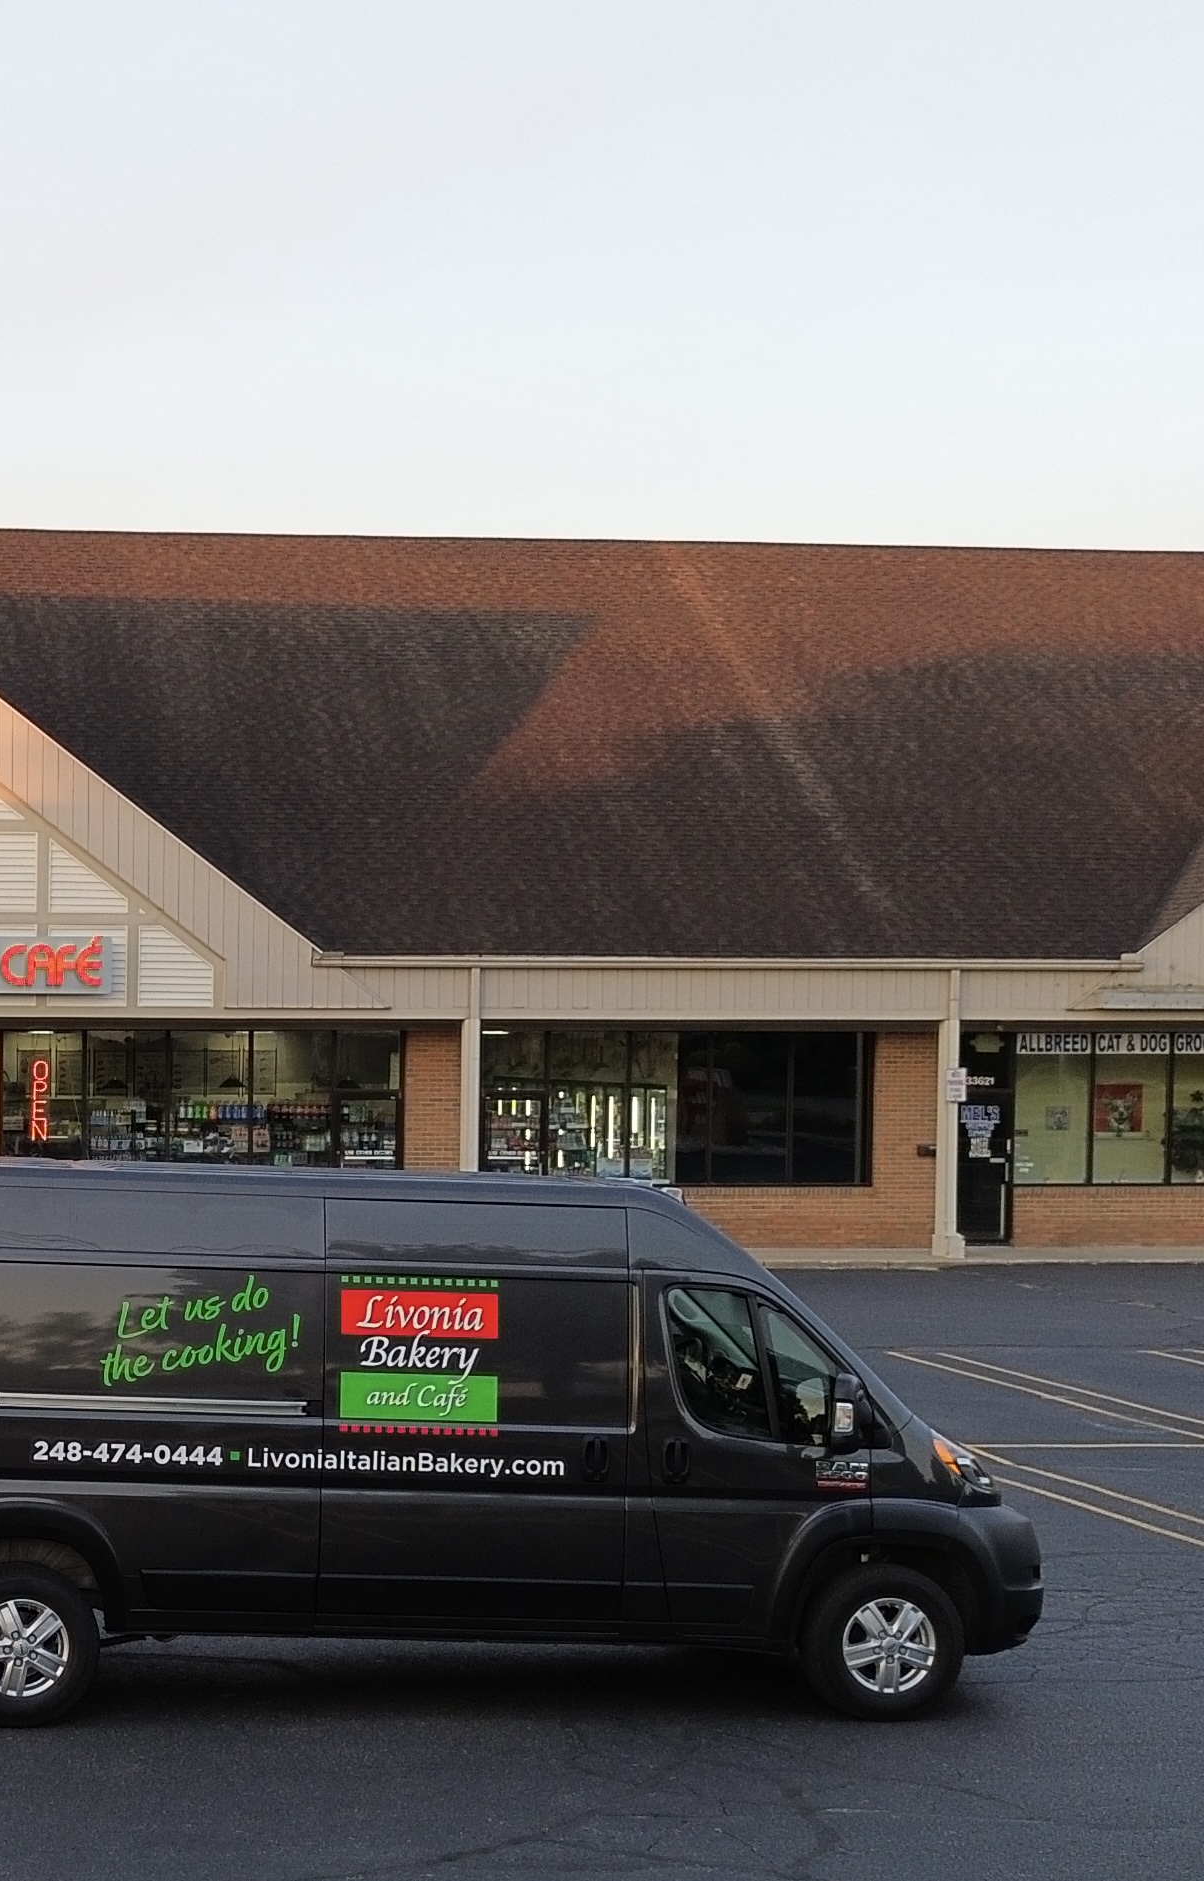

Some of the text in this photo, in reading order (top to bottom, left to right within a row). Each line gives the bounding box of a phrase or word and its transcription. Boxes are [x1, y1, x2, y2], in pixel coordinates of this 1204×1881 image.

[0, 935, 104, 987] CAFÉ
[1019, 1034, 1204, 1053] ALLBREED CAT & DOG GRO
[30, 1060, 49, 1141] OPEN
[117, 1274, 269, 1339] Let us do
[356, 1295, 484, 1331] Livonia
[100, 1313, 301, 1387] the cooking!
[360, 1330, 480, 1385] Bakery
[366, 1382, 469, 1417] and Café
[33, 1441, 566, 1477] 248-474-0444 LivoniaItalianBakery.com
